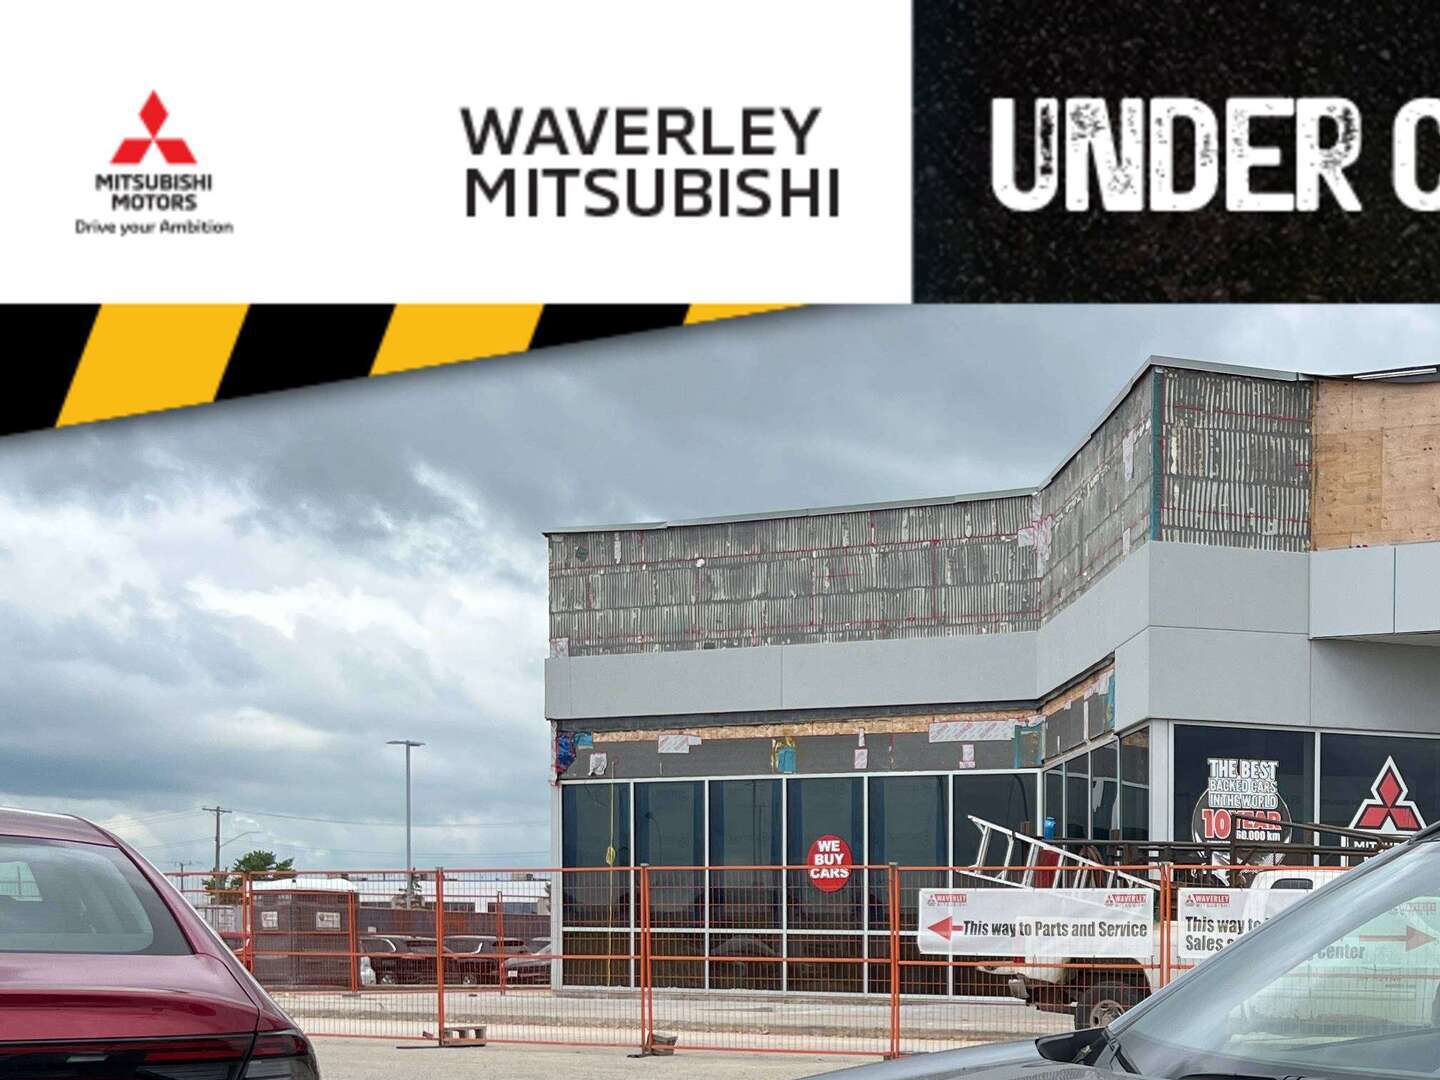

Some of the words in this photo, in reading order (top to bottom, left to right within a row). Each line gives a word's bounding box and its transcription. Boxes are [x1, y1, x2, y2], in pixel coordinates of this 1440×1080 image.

[1208, 758, 1238, 779] THE
[1240, 759, 1279, 780] BEST
[1209, 780, 1249, 792] BACKED
[1251, 780, 1278, 793] CARS
[1220, 793, 1241, 807] THE
[1241, 794, 1279, 809] WORLD
[1202, 809, 1232, 839] 10
[817, 840, 841, 852] WE
[814, 853, 845, 866] BUY
[810, 867, 850, 879] CARS
[1194, 894, 1229, 903] WAVERLEY
[963, 920, 989, 936] This
[991, 922, 1016, 938] way
[1019, 921, 1032, 936] to
[1034, 921, 1069, 937] Parts
[1071, 921, 1096, 937] and
[1098, 920, 1148, 937] Service
[1185, 916, 1215, 932] This
[1217, 919, 1245, 935] way
[1185, 934, 1224, 952] Sales
